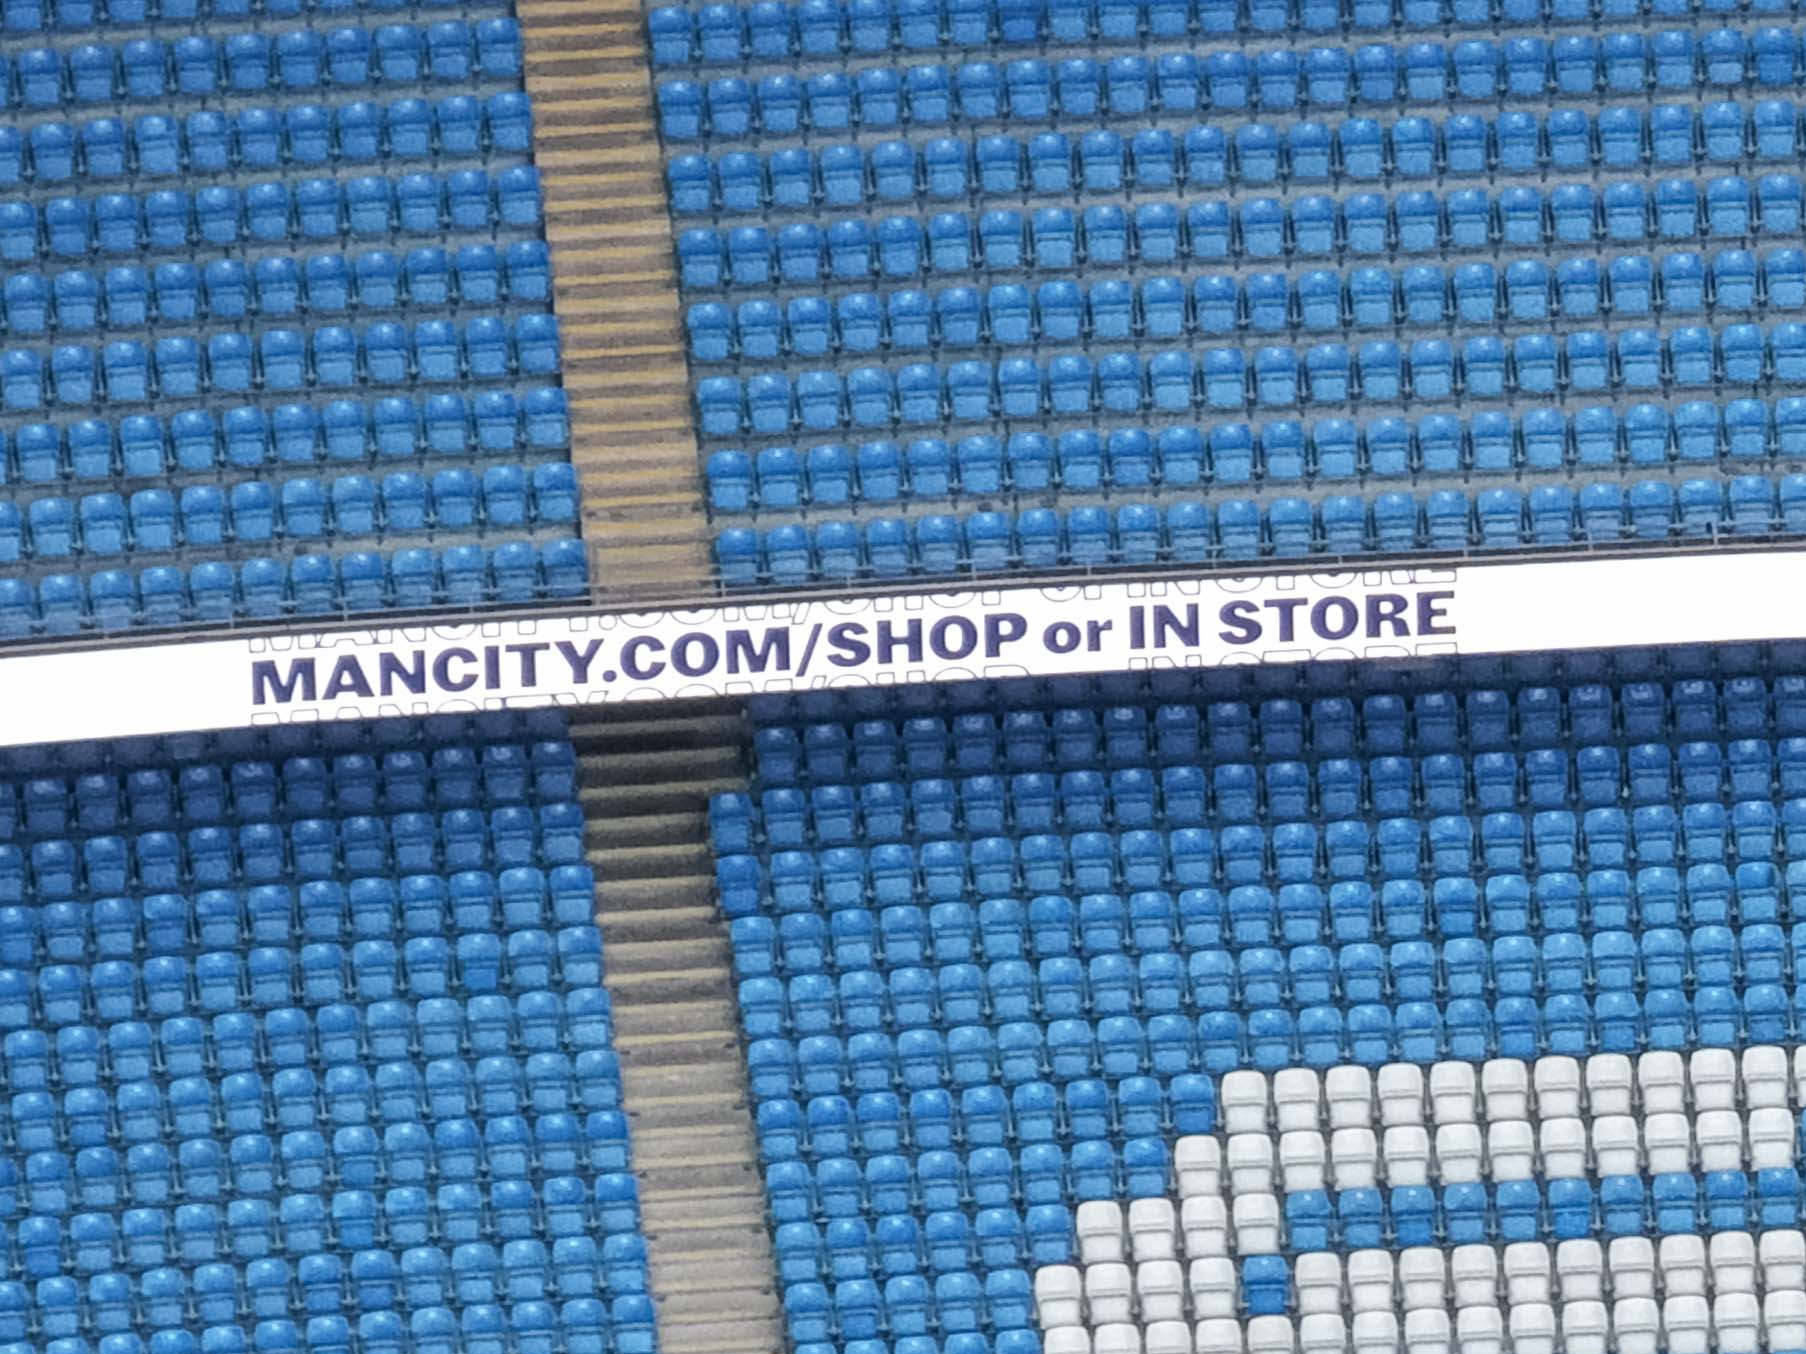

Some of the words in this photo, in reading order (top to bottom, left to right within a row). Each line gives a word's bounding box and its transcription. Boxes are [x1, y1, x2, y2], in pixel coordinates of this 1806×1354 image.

[251, 613, 1029, 706] MANCITY.COM/SHOP
[1043, 621, 1114, 655] or
[1130, 603, 1201, 651] IN
[1218, 590, 1457, 646] STORE
